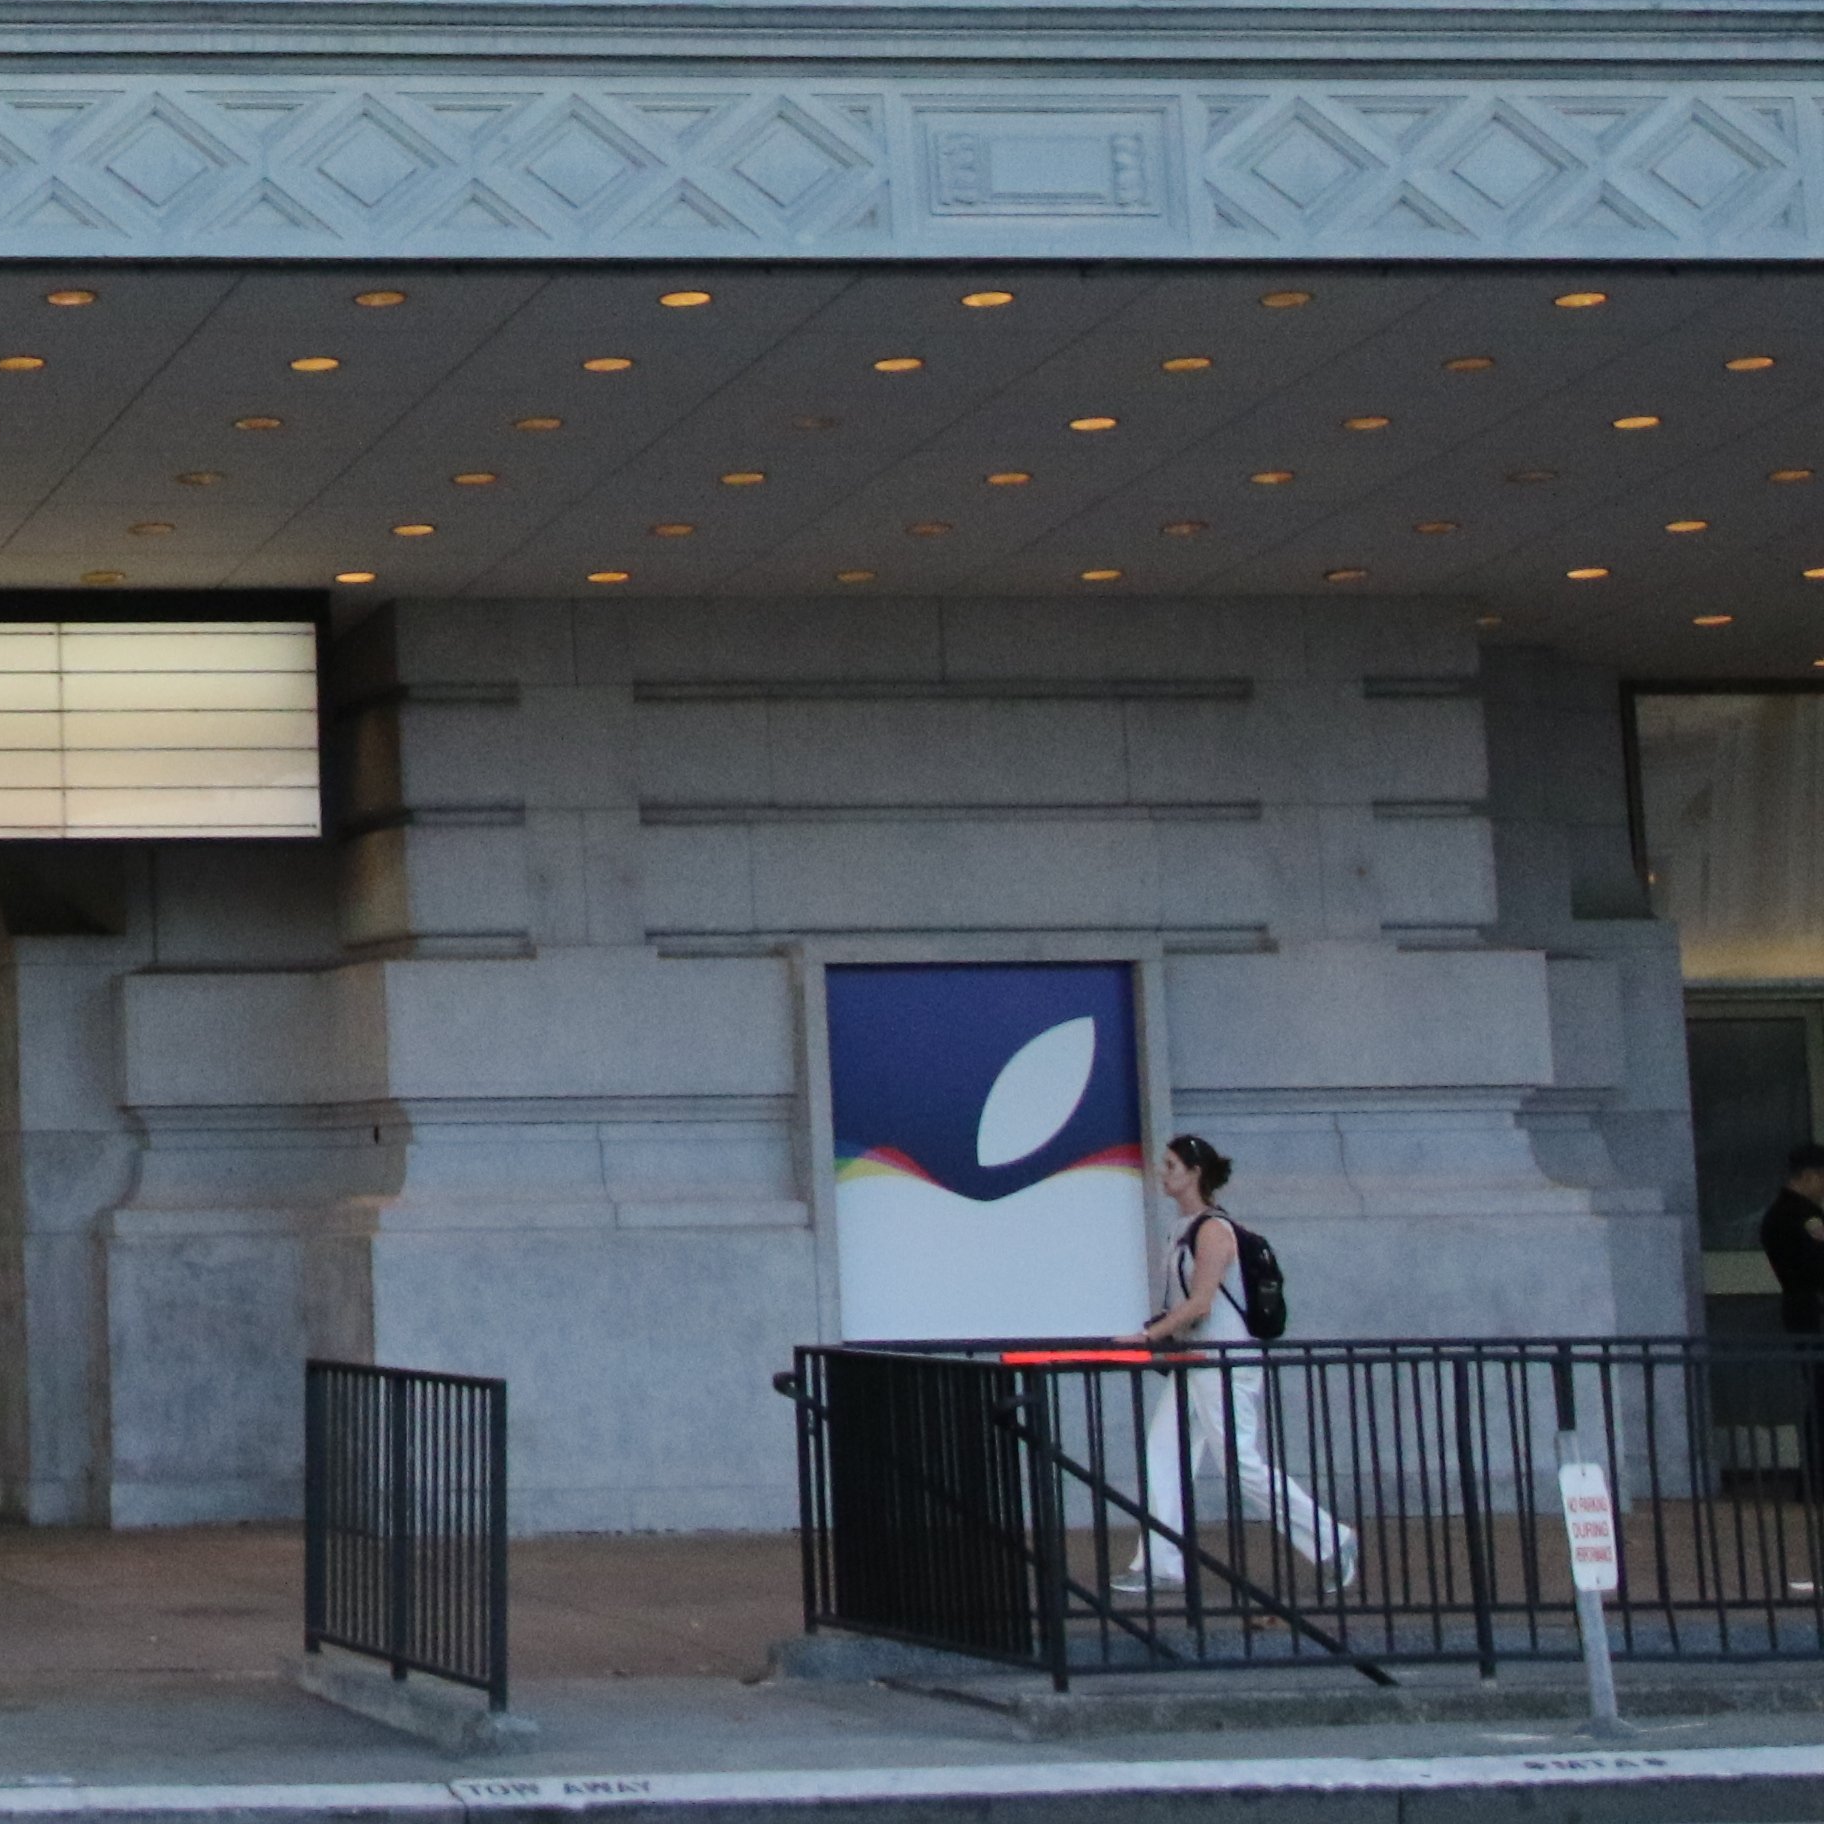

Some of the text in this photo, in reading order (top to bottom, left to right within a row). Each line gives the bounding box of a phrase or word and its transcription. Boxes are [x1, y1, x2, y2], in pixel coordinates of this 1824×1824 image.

[1572, 1521, 1610, 1539] DURING
[463, 1780, 650, 1796] TOW AWAY
